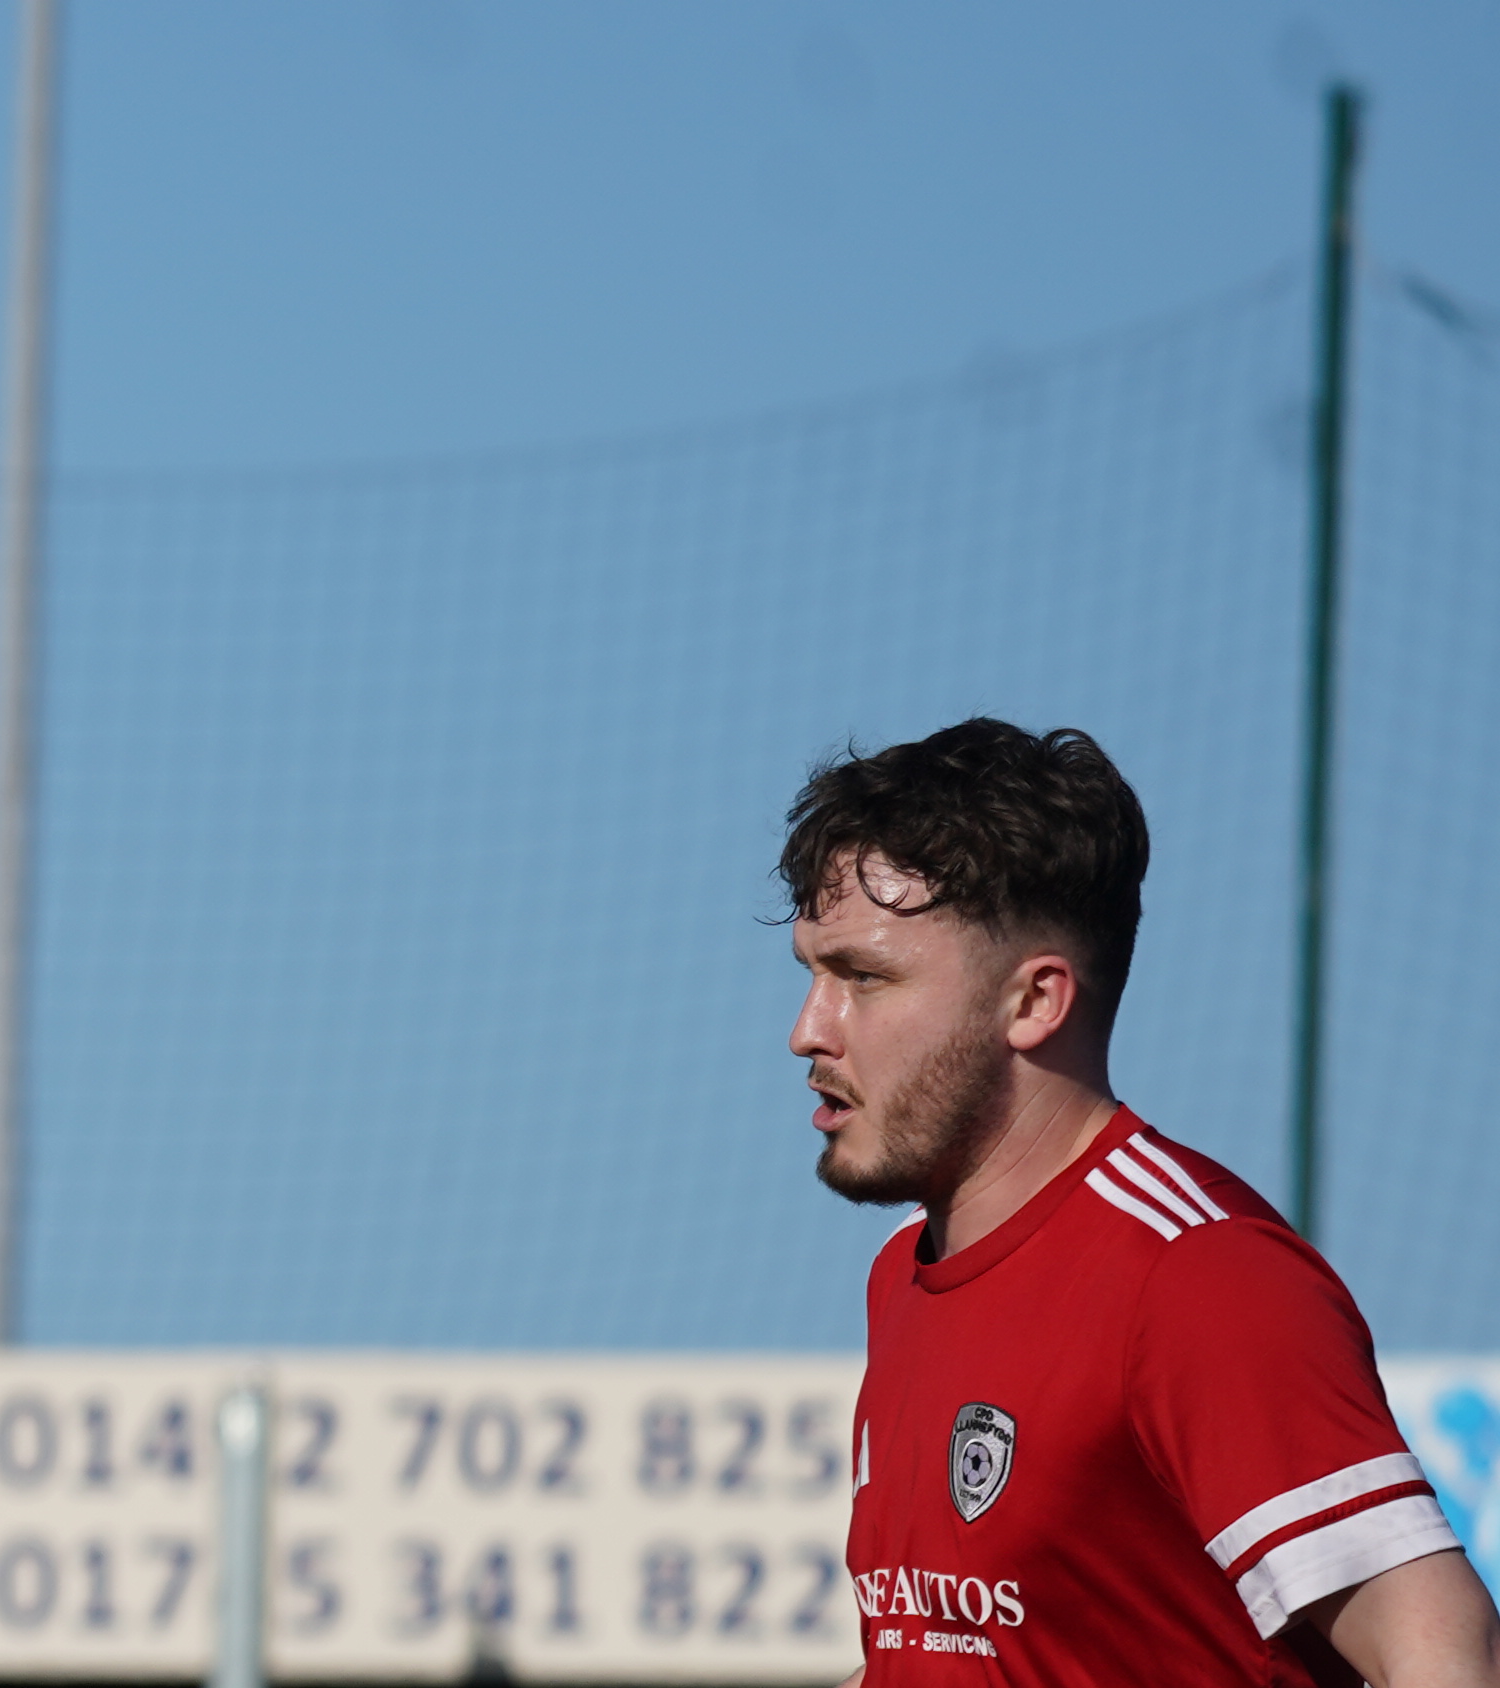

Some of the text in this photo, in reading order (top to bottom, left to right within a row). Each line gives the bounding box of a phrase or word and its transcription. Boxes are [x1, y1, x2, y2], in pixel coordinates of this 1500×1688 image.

[393, 1394, 592, 1496] 702
[636, 1396, 846, 1496] 825
[636, 1544, 846, 1640] 822
